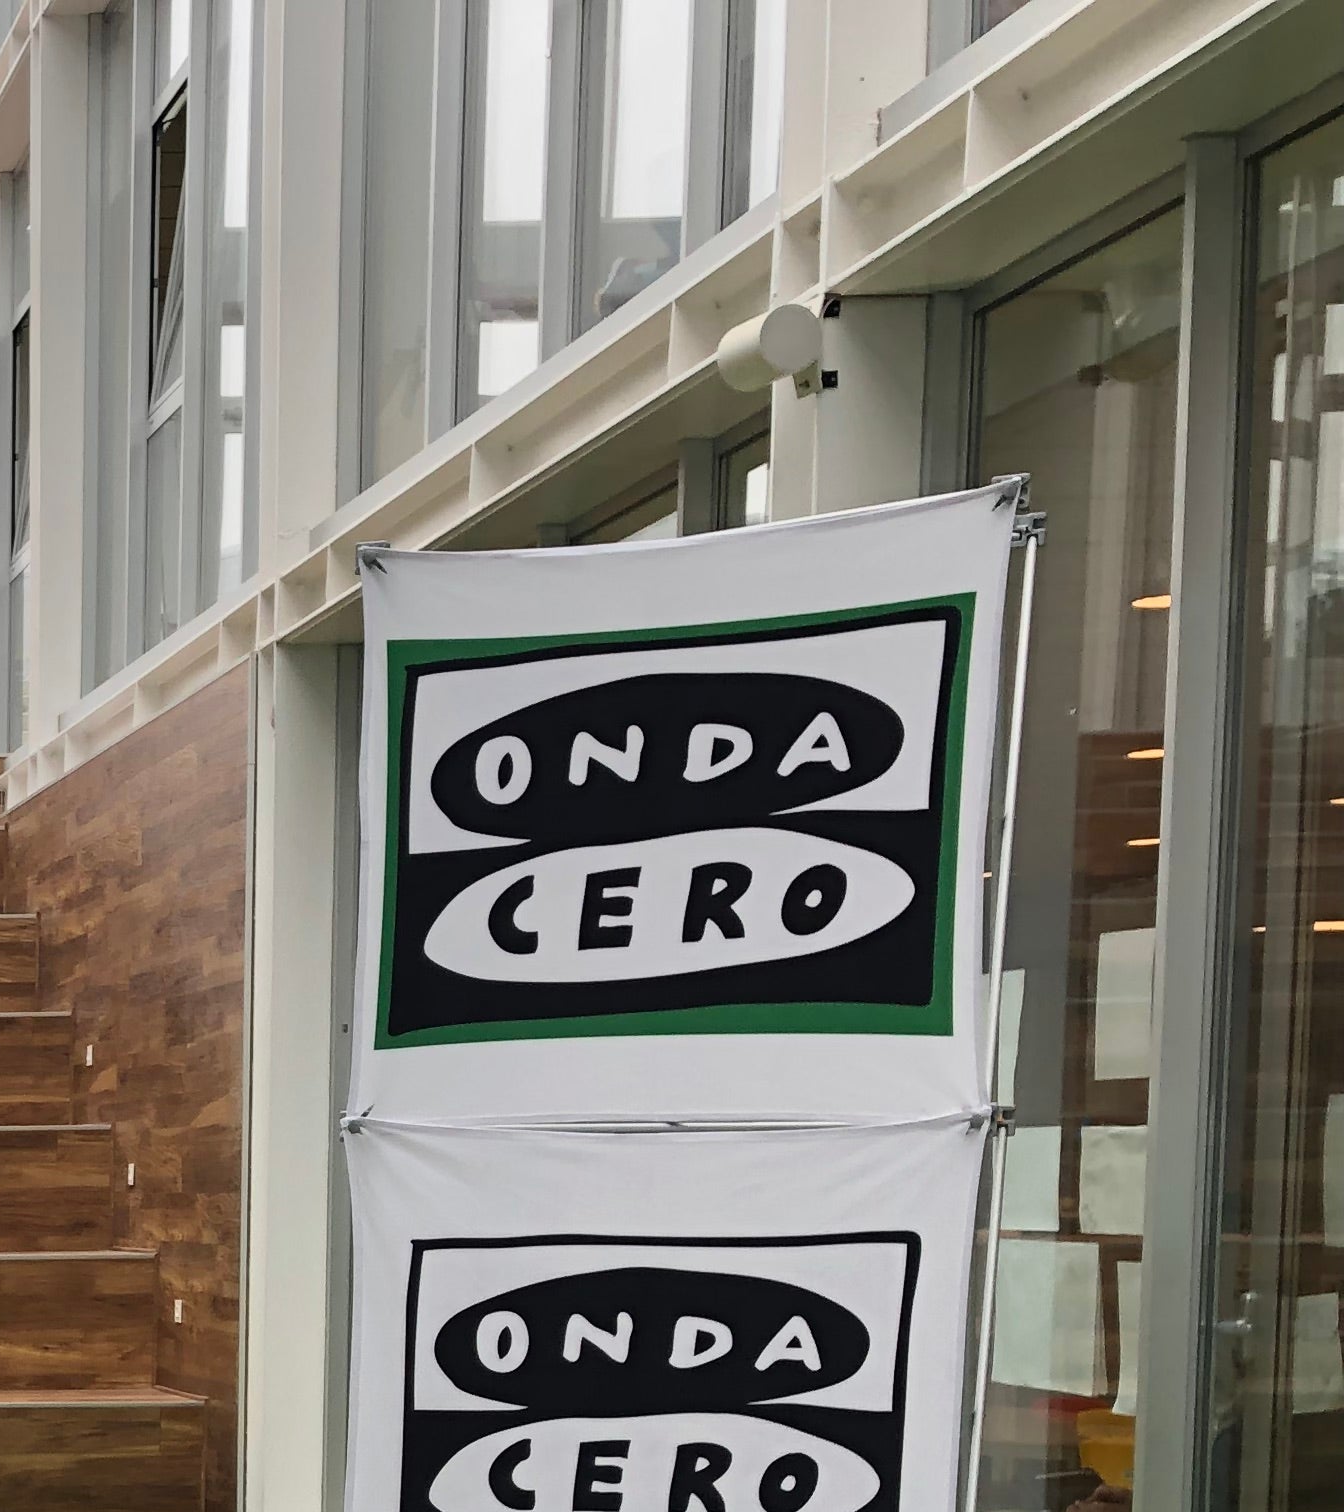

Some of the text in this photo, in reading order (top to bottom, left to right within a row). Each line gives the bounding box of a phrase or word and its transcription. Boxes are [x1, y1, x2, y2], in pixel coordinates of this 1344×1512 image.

[474, 711, 851, 806] ONDA
[487, 860, 849, 956] CERO
[475, 1309, 823, 1374] ONDA
